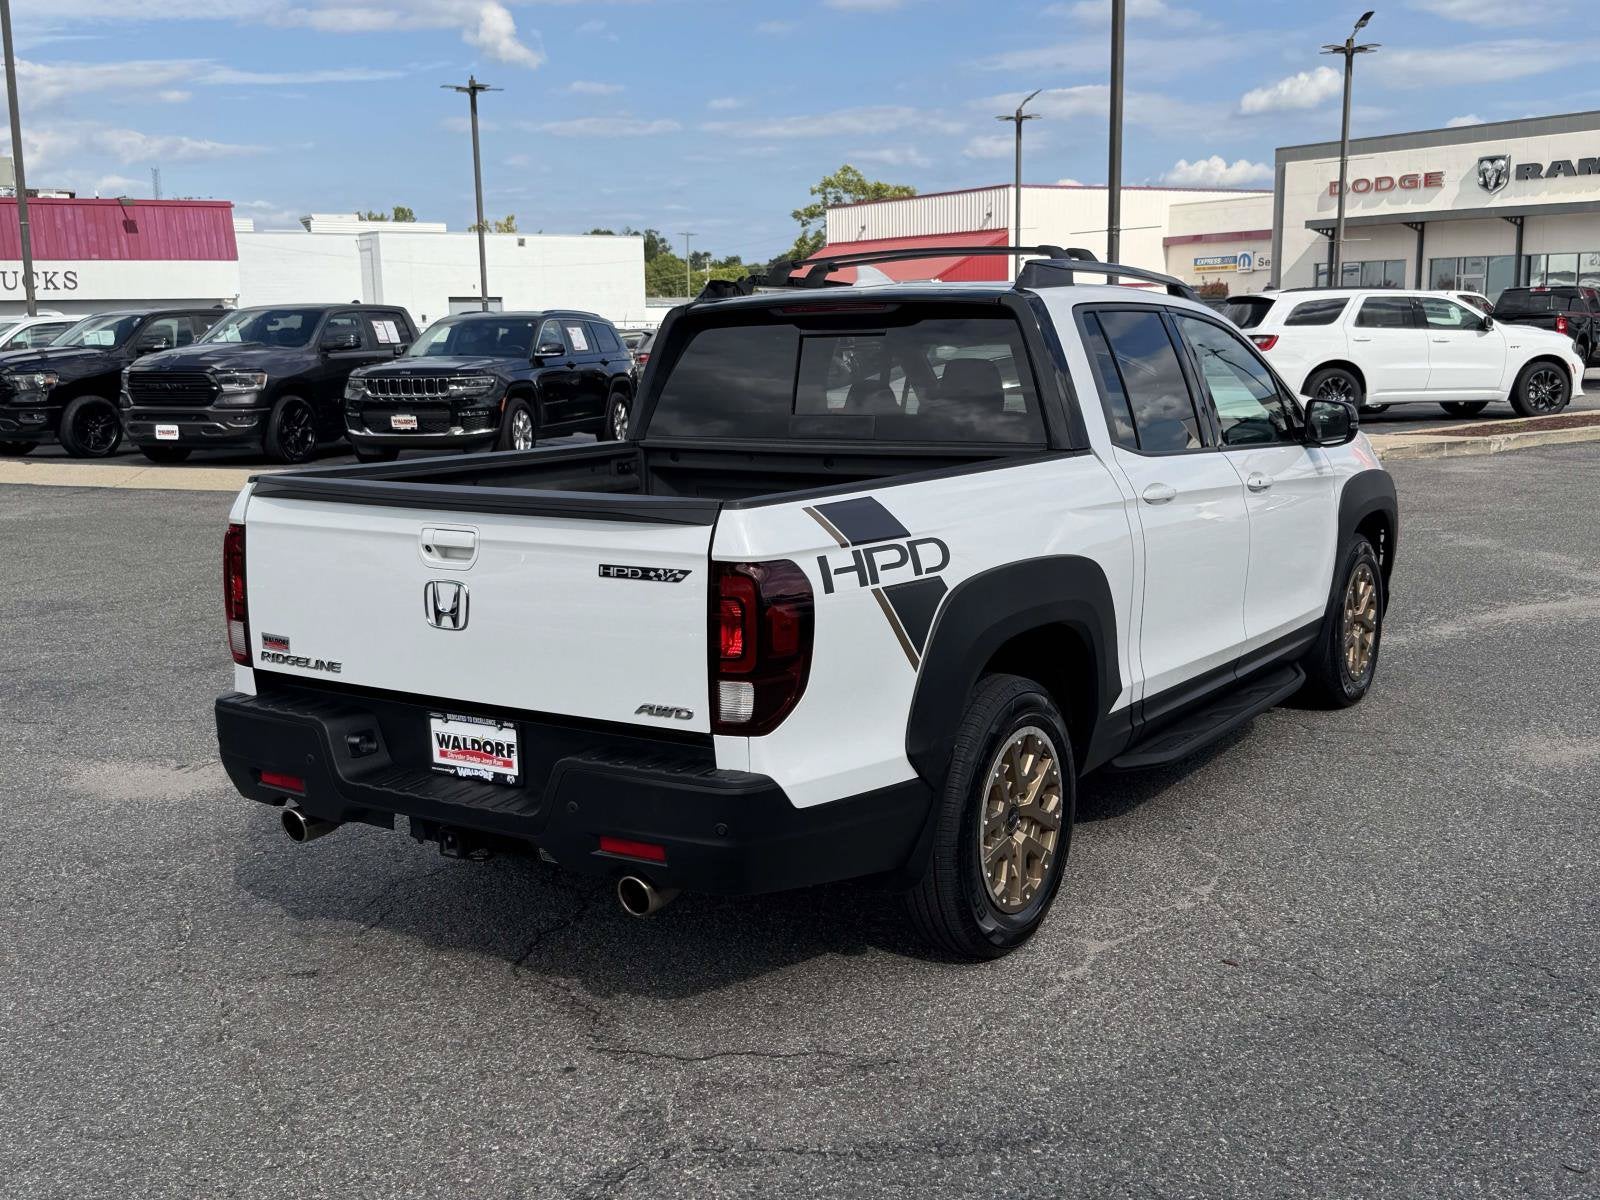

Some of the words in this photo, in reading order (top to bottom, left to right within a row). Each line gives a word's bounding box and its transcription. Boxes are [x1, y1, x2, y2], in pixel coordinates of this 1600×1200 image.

[1328, 171, 1446, 196] DODGE
[600, 566, 642, 578] HPD
[816, 537, 950, 594] HPD
[261, 651, 342, 673] RIDGELINE
[634, 704, 694, 720] AWD
[435, 732, 515, 759] WALDORF
